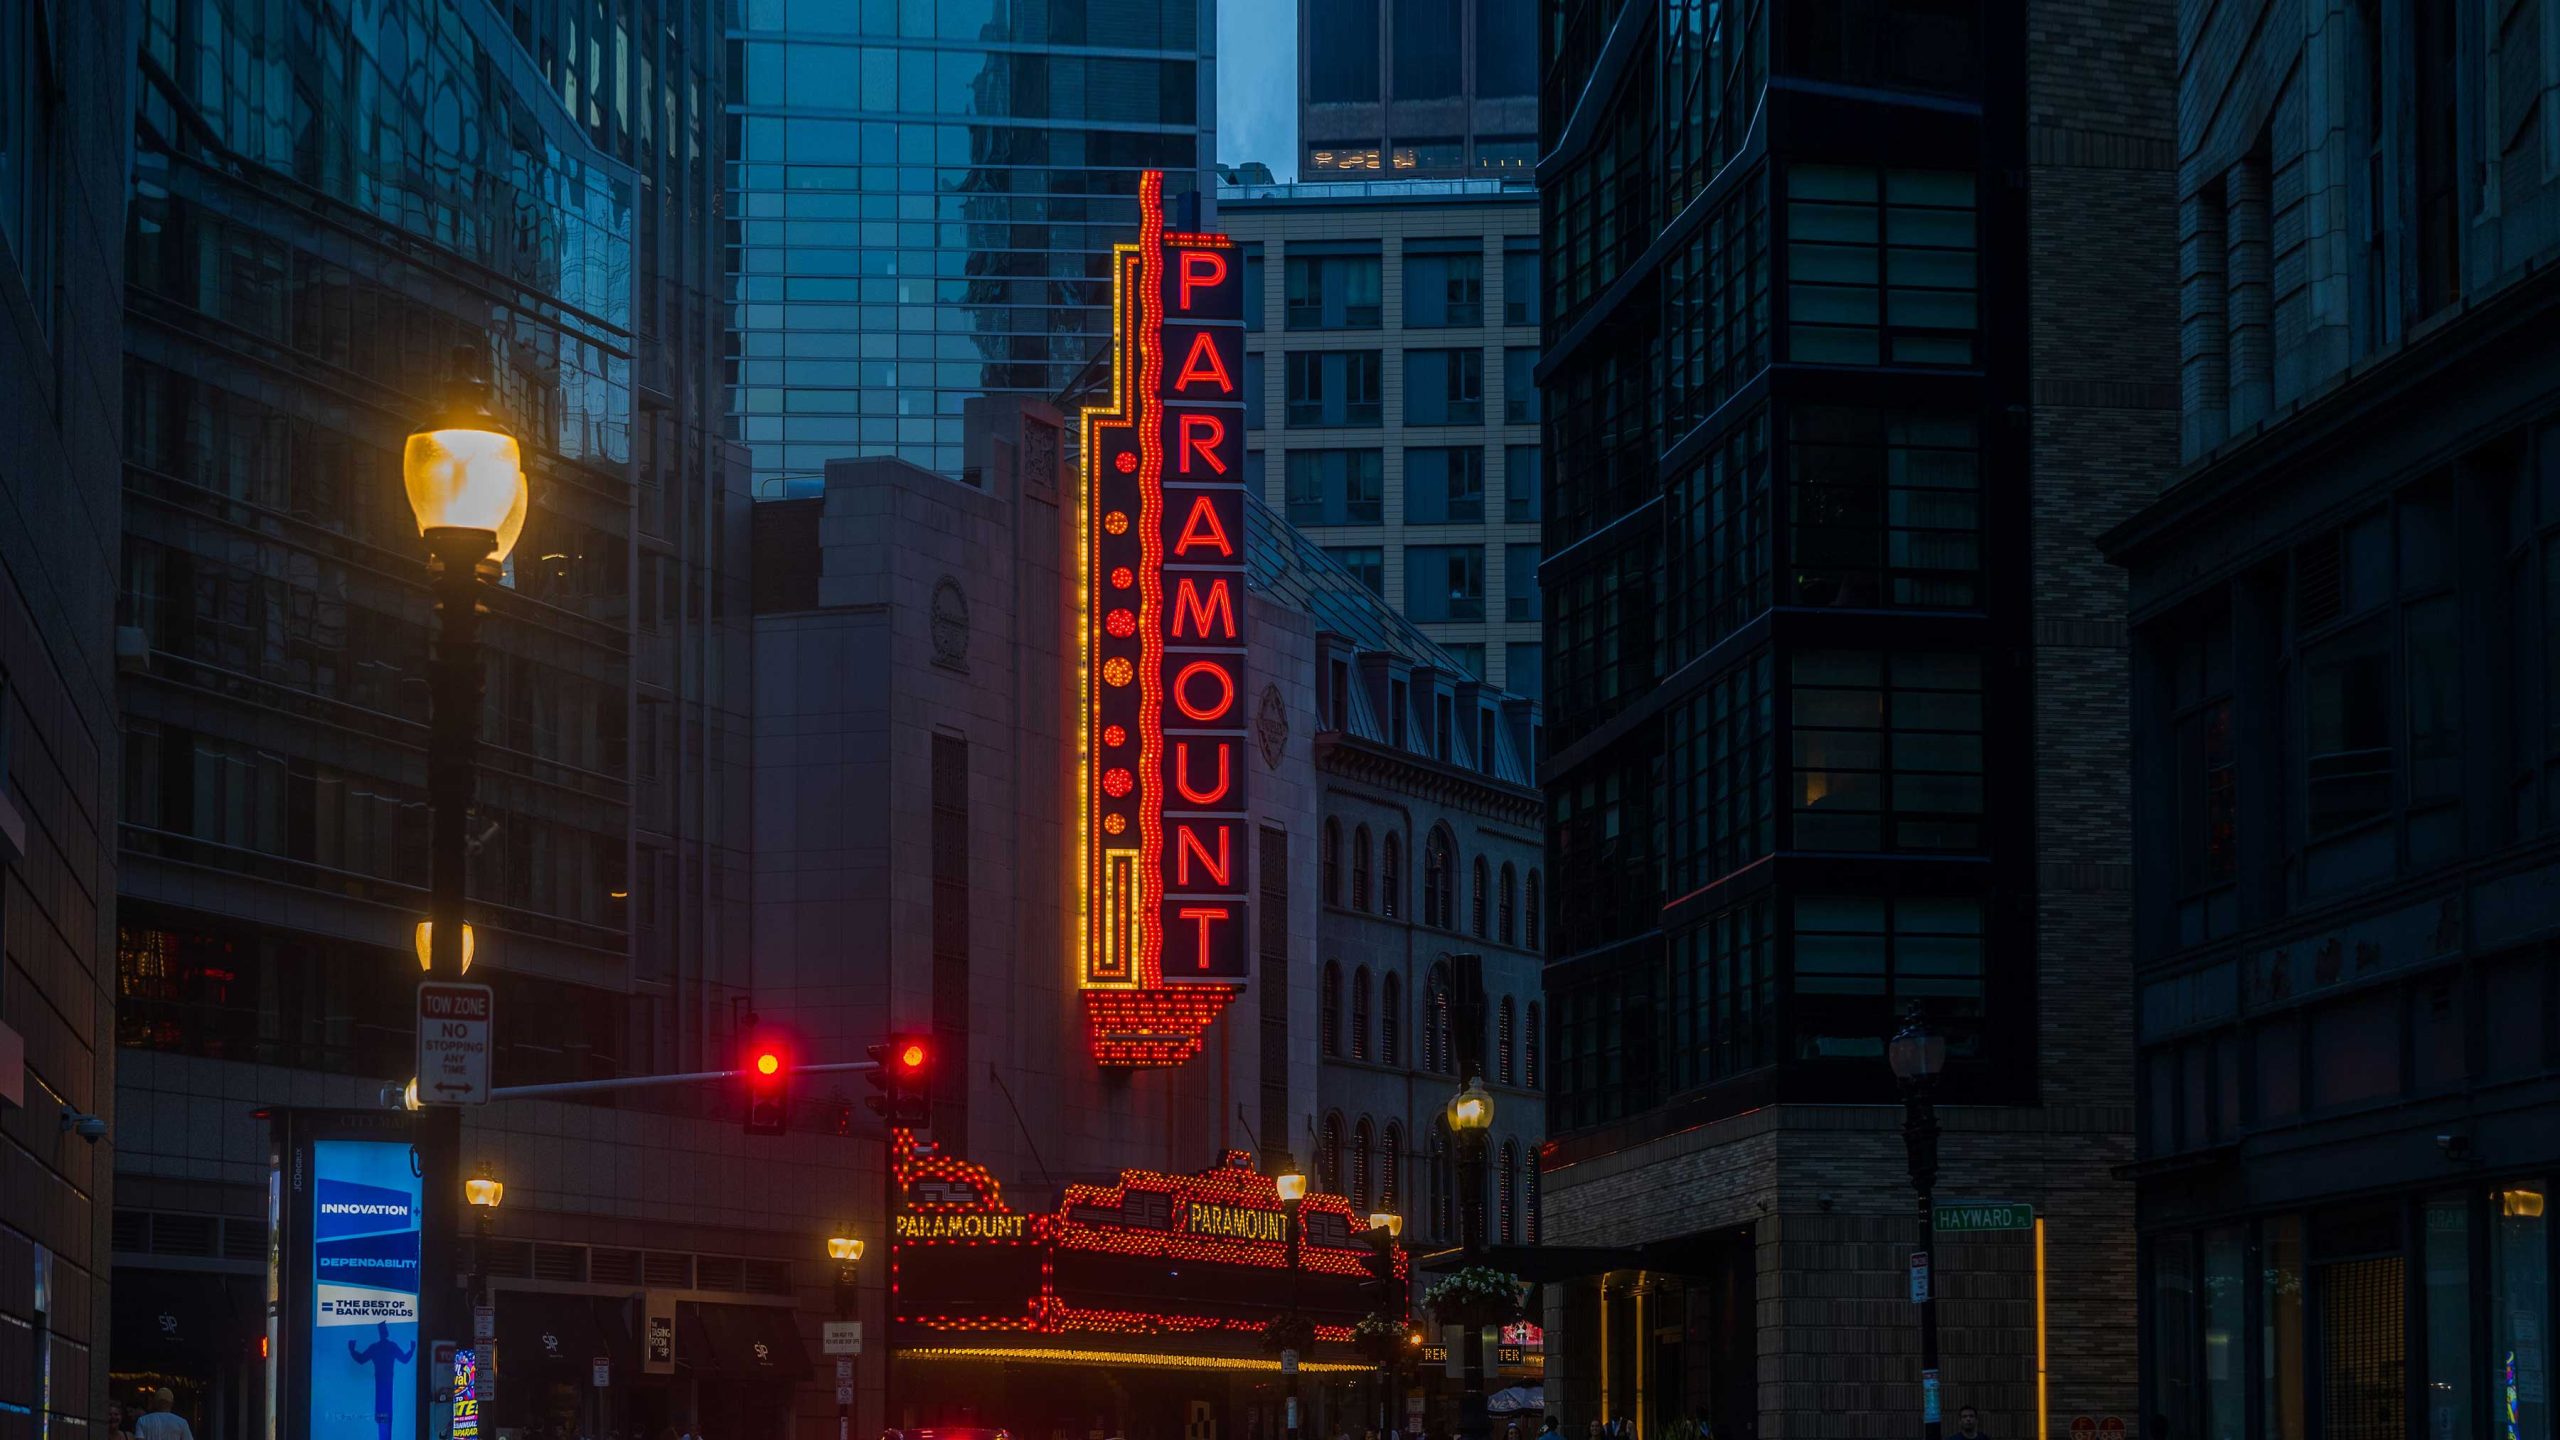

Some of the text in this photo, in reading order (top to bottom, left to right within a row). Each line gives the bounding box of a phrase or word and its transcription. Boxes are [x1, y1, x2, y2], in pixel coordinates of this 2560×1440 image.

[1172, 251, 1236, 969] PARAMOUNT
[425, 995, 486, 1017] TOW ZONE
[441, 1022, 468, 1038] NO
[425, 1040, 483, 1053] STOPPING
[443, 1054, 466, 1064] ANY
[442, 1064, 466, 1075] TIME
[320, 1203, 408, 1216] INNOVATION
[1190, 1202, 1289, 1243] PARAMOUNT
[1939, 1208, 2013, 1229] HAYWARD
[895, 1213, 1026, 1239] PARAMOUNT
[320, 1257, 417, 1269] DEPENDABILITY
[335, 1300, 405, 1309] THE BEST OF
[336, 1308, 413, 1317] BANK WORLDS
[1422, 1348, 1447, 1361] REN
